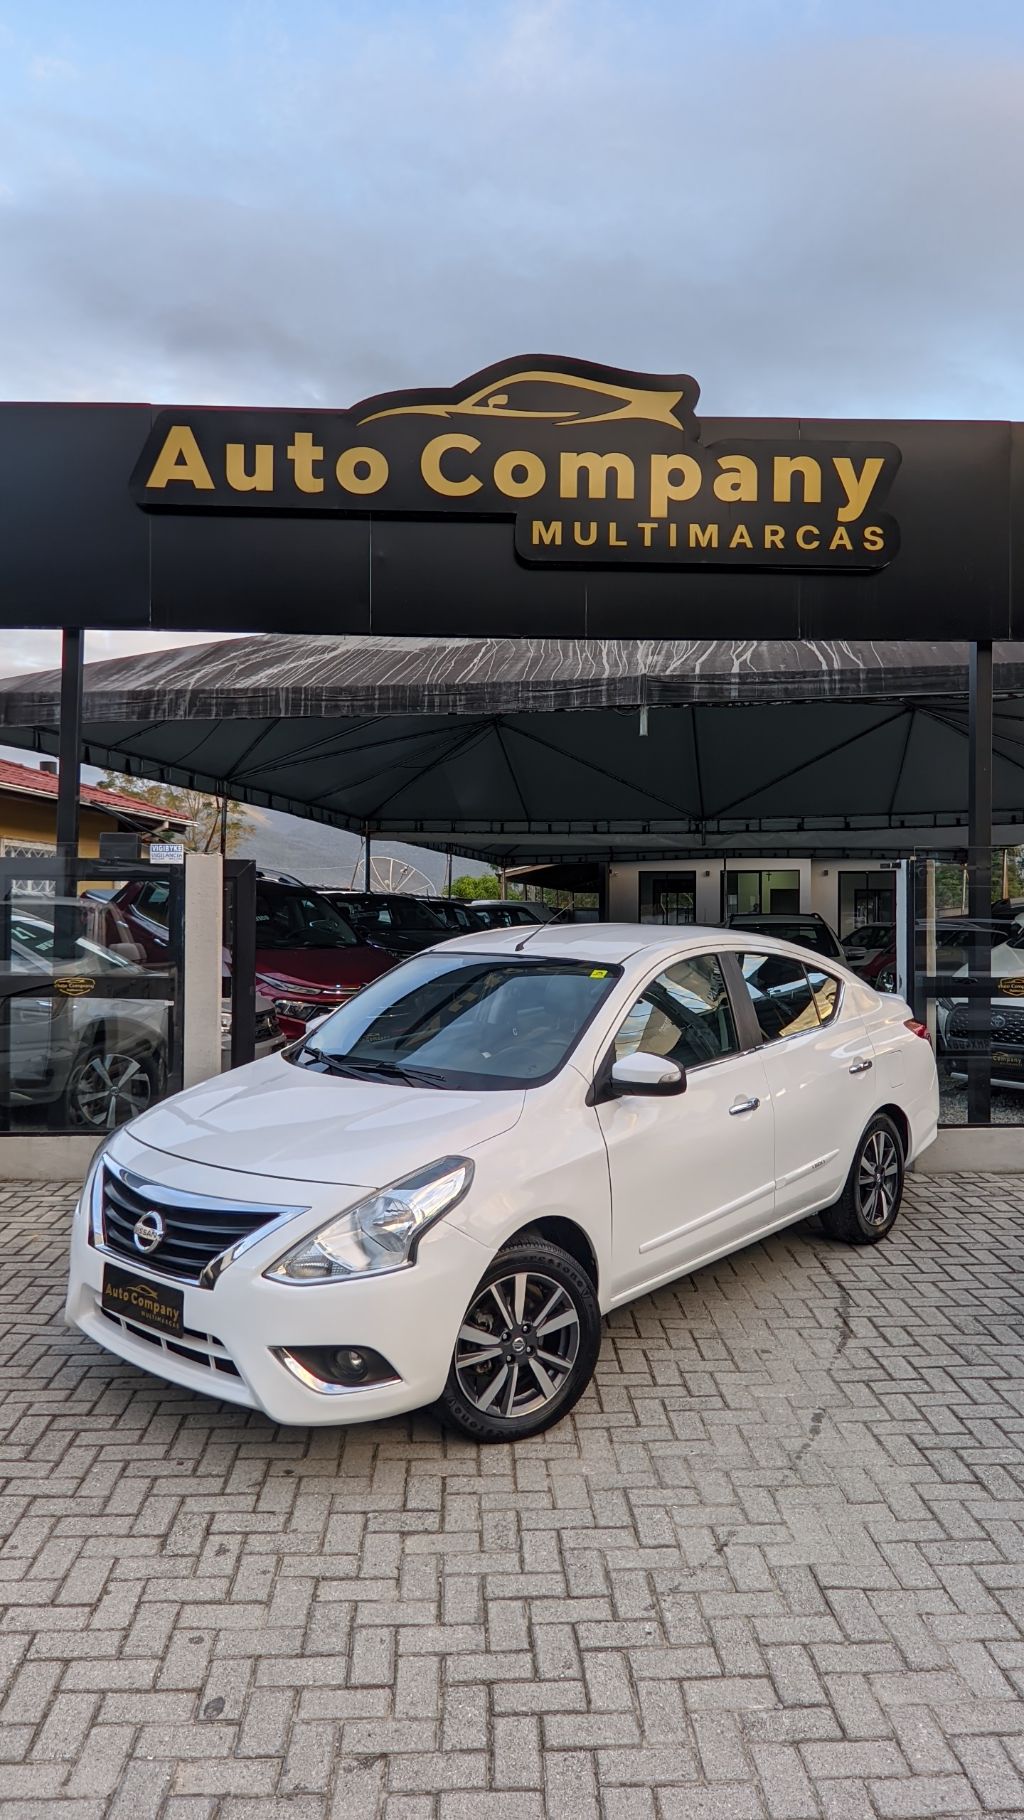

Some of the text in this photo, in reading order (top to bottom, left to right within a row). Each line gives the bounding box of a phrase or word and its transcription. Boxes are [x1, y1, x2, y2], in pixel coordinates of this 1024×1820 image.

[145, 425, 885, 523] Auto Company
[532, 520, 886, 552] MULTIMARCAS
[105, 1283, 180, 1321] Auto Company
